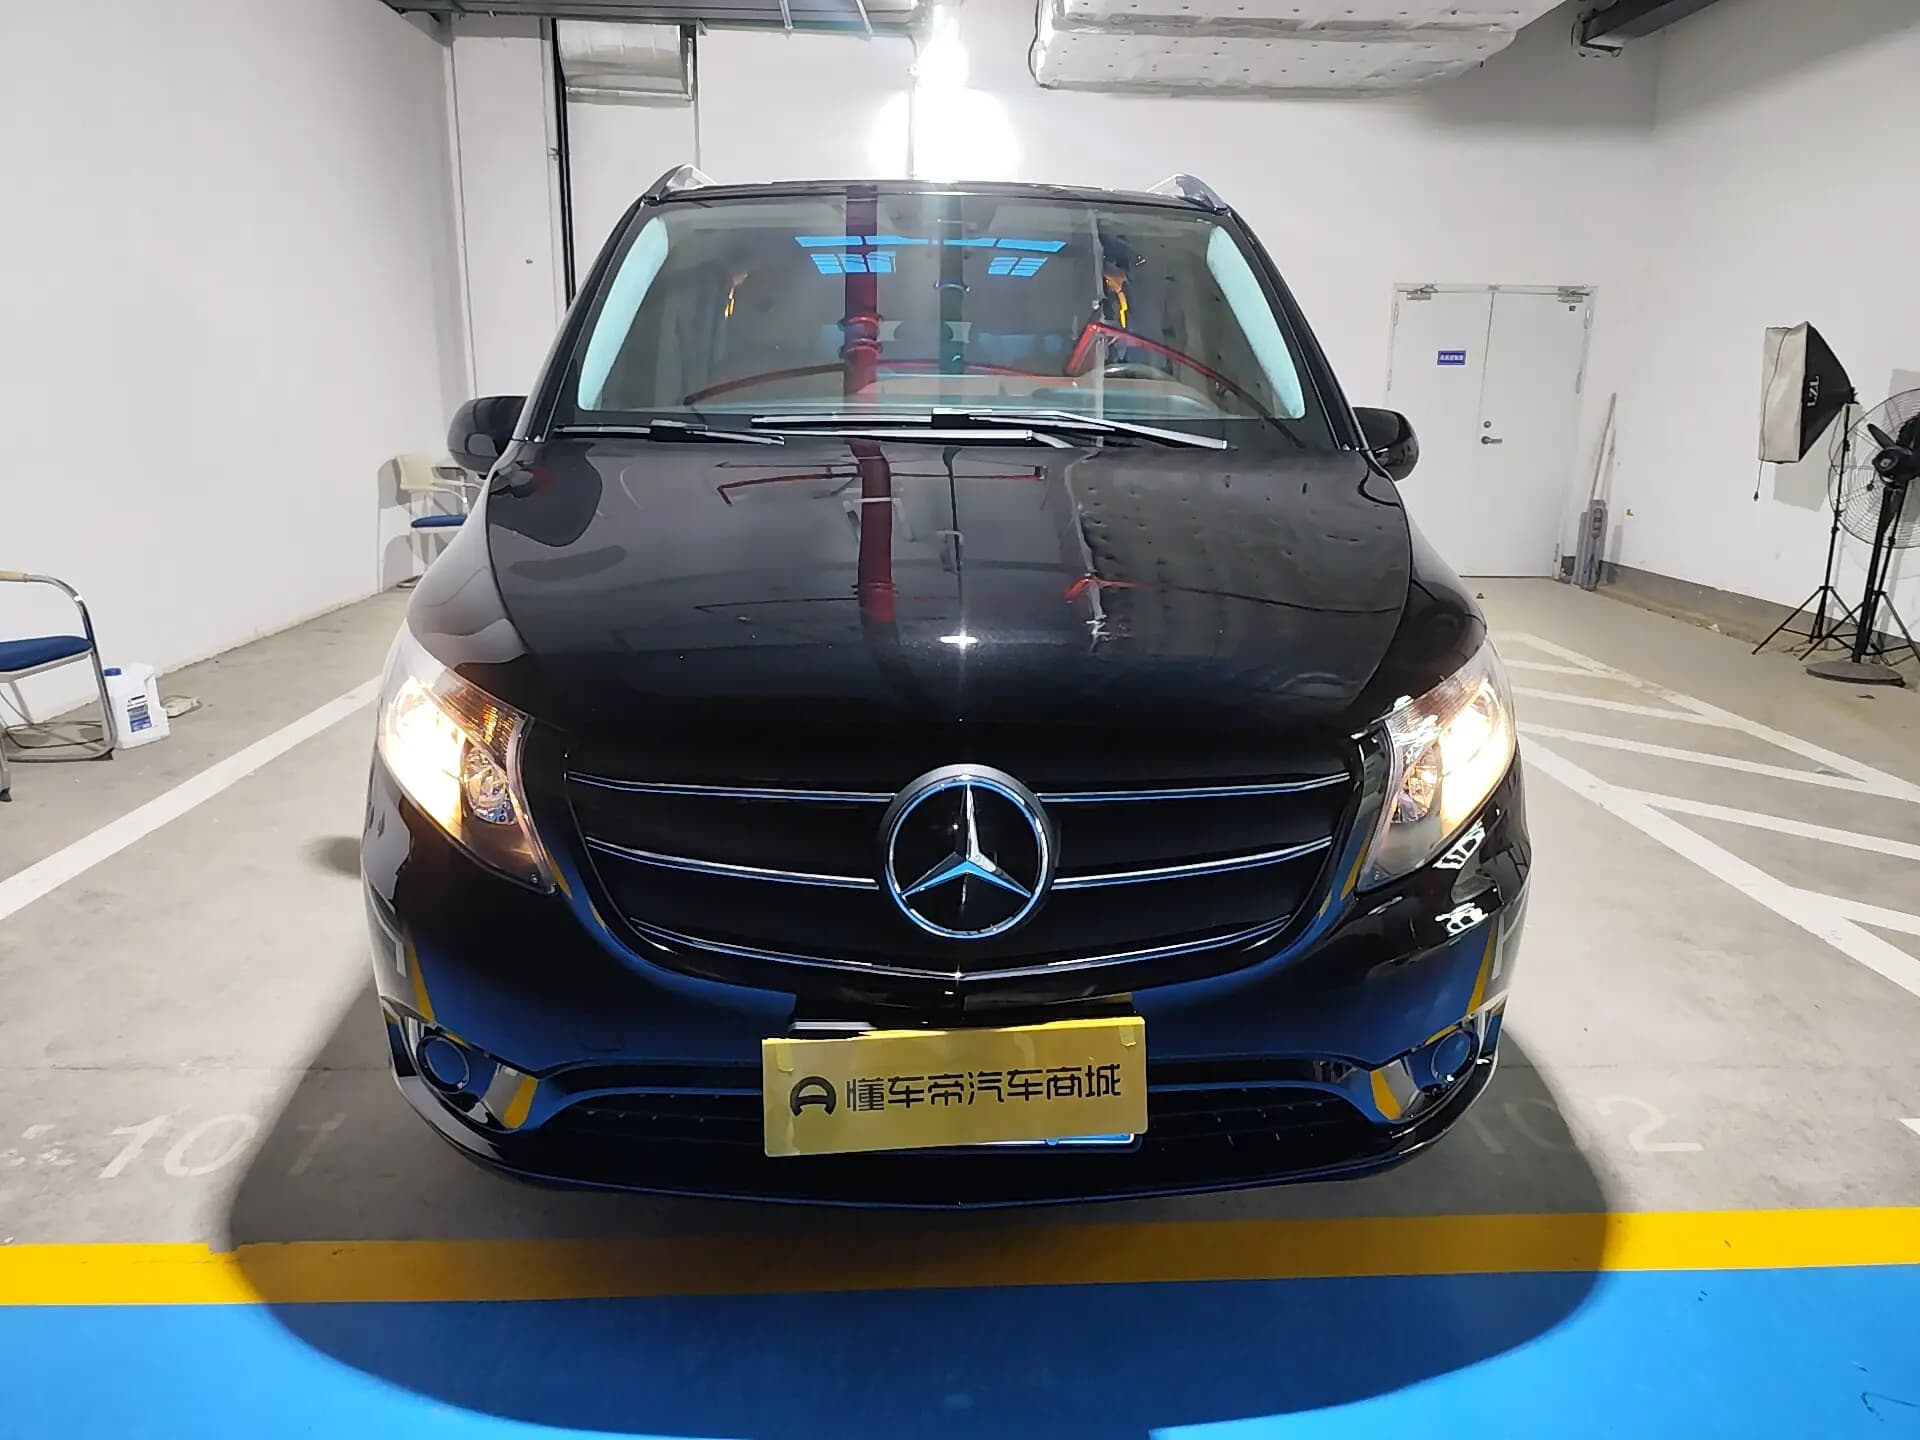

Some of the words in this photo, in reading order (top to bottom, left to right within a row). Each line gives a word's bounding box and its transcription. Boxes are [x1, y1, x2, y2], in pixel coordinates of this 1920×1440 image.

[846, 1063, 1121, 1112] 懂车帝汽车商城
